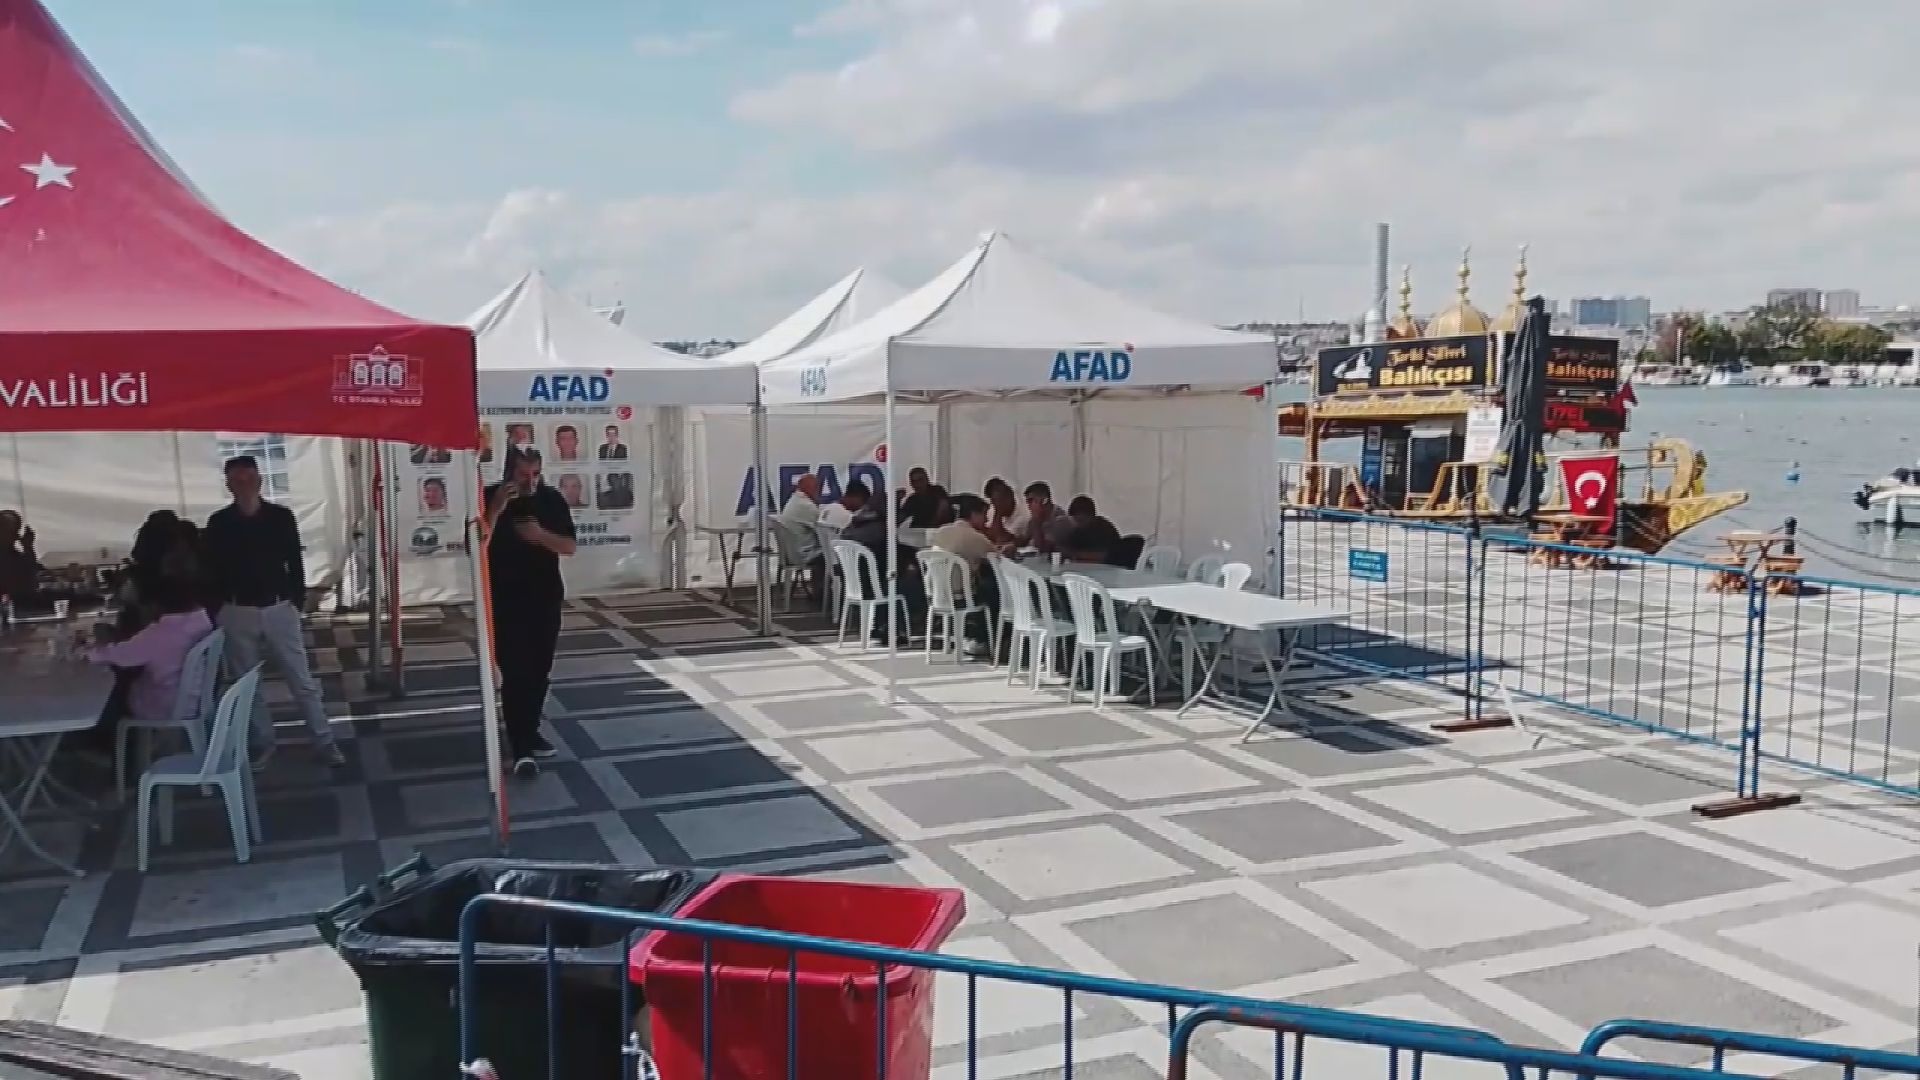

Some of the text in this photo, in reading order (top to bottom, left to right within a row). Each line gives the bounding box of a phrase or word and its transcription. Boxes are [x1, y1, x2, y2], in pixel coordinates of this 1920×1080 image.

[800, 365, 827, 397] AFAD
[1051, 351, 1131, 381] AFAD
[1380, 366, 1475, 388] Balıkçısı
[0, 371, 148, 407] VALİLİĞİ
[529, 375, 610, 402] AFAD
[734, 463, 888, 517] AFAD
